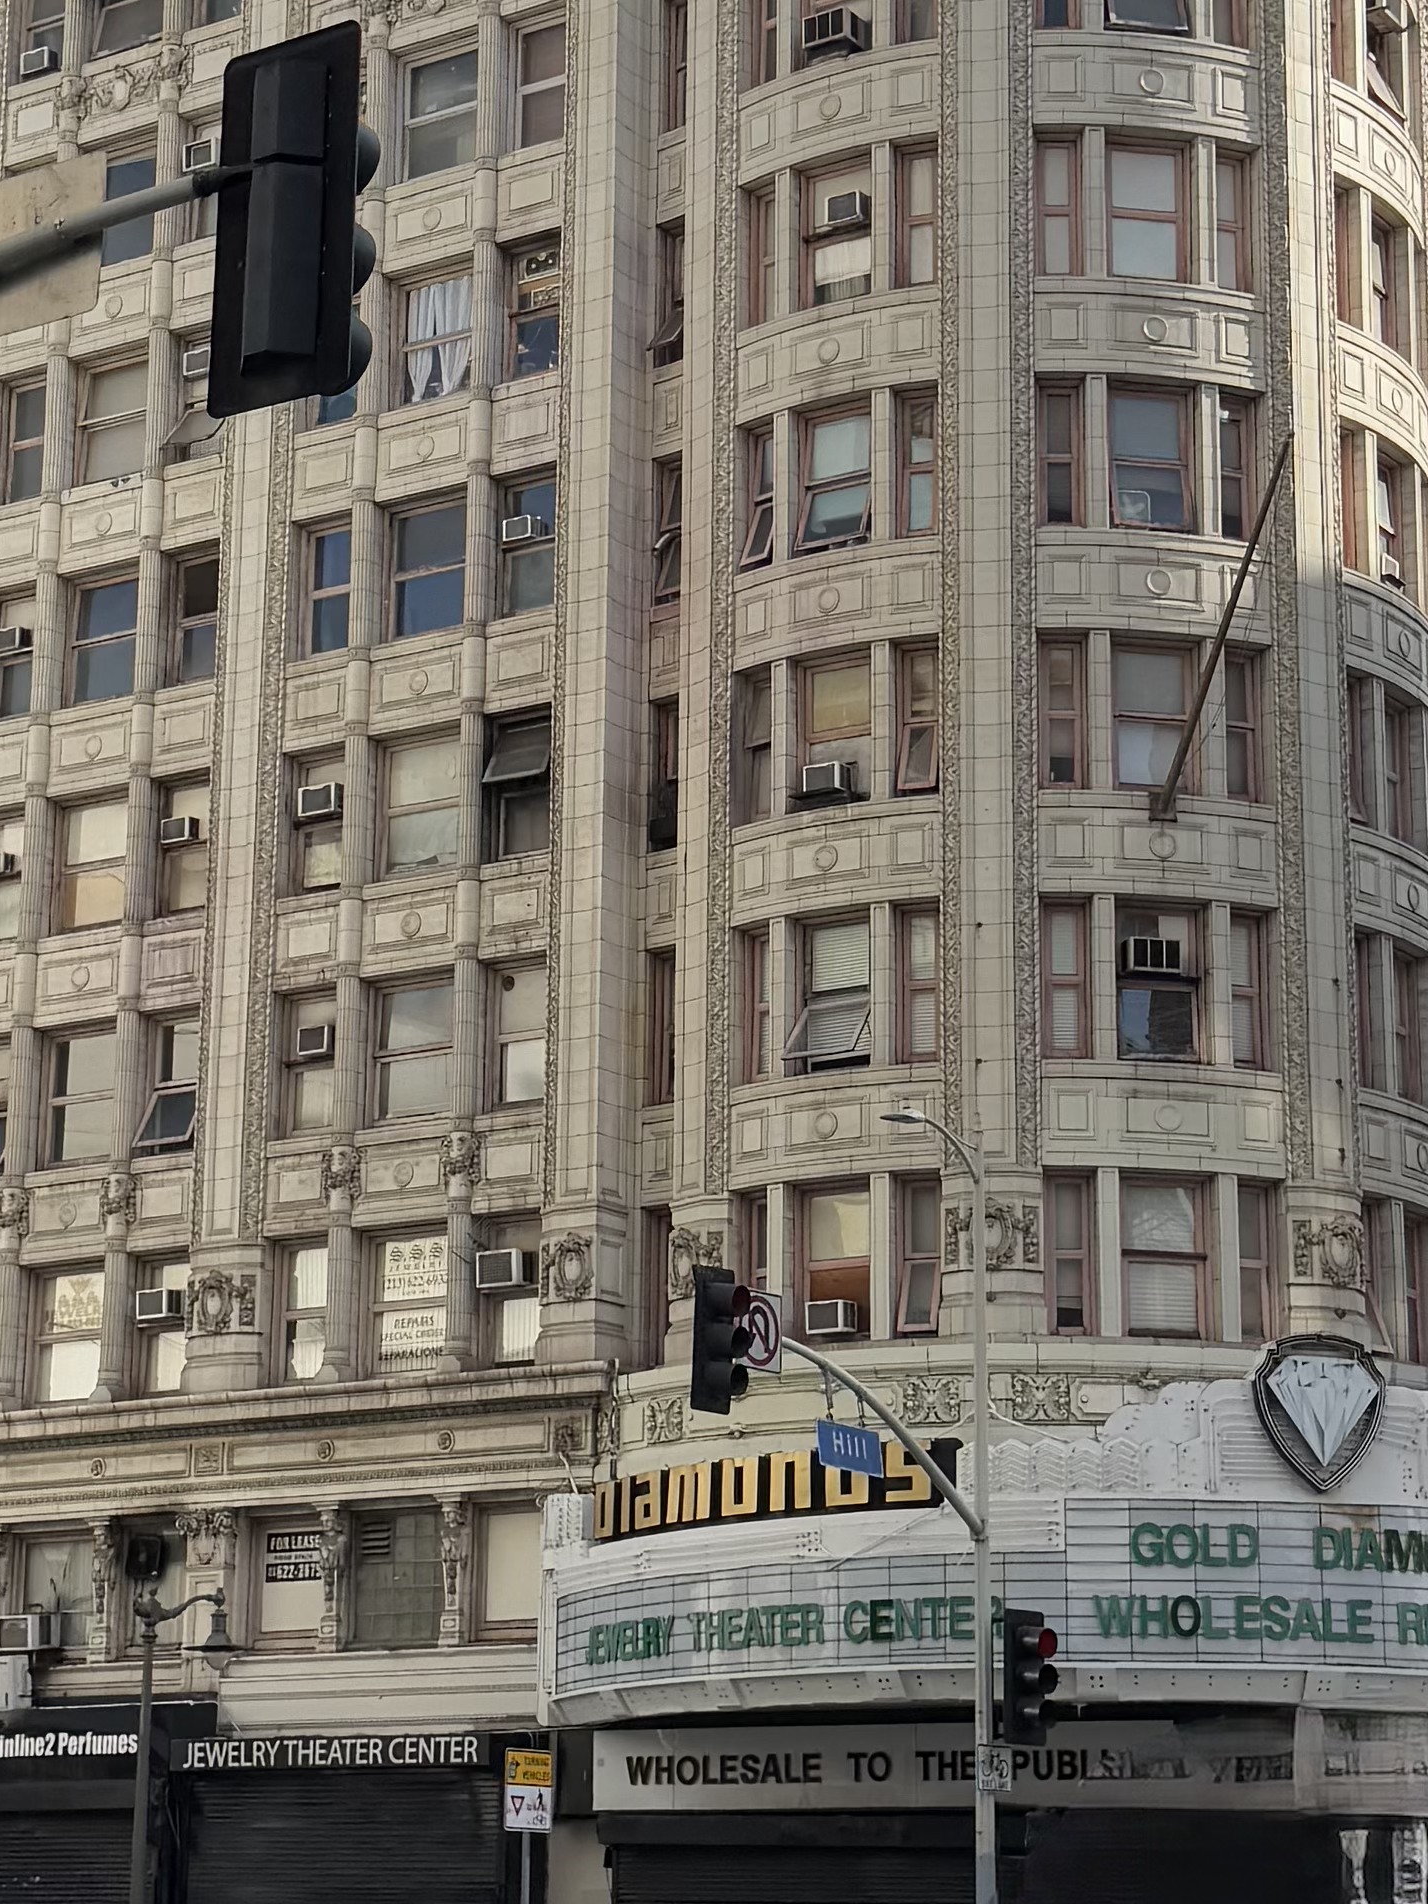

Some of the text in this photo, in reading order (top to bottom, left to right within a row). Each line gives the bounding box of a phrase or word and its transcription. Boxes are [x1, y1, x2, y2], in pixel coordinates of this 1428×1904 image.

[832, 1428, 868, 1460] Hill
[270, 1534, 322, 1551] FOR LEASE
[1129, 1522, 1259, 1569] GOLD
[584, 1614, 675, 1667] JEWELRY
[687, 1602, 826, 1653] THEATER
[1092, 1594, 1375, 1643] WHOLESALE
[57, 1731, 139, 1757] Perfumes
[183, 1736, 479, 1769] JEWELRY THEATER CENTER
[626, 1752, 822, 1786] WHOLESALE
[847, 1751, 892, 1783] TO
[916, 1750, 977, 1781] THE
